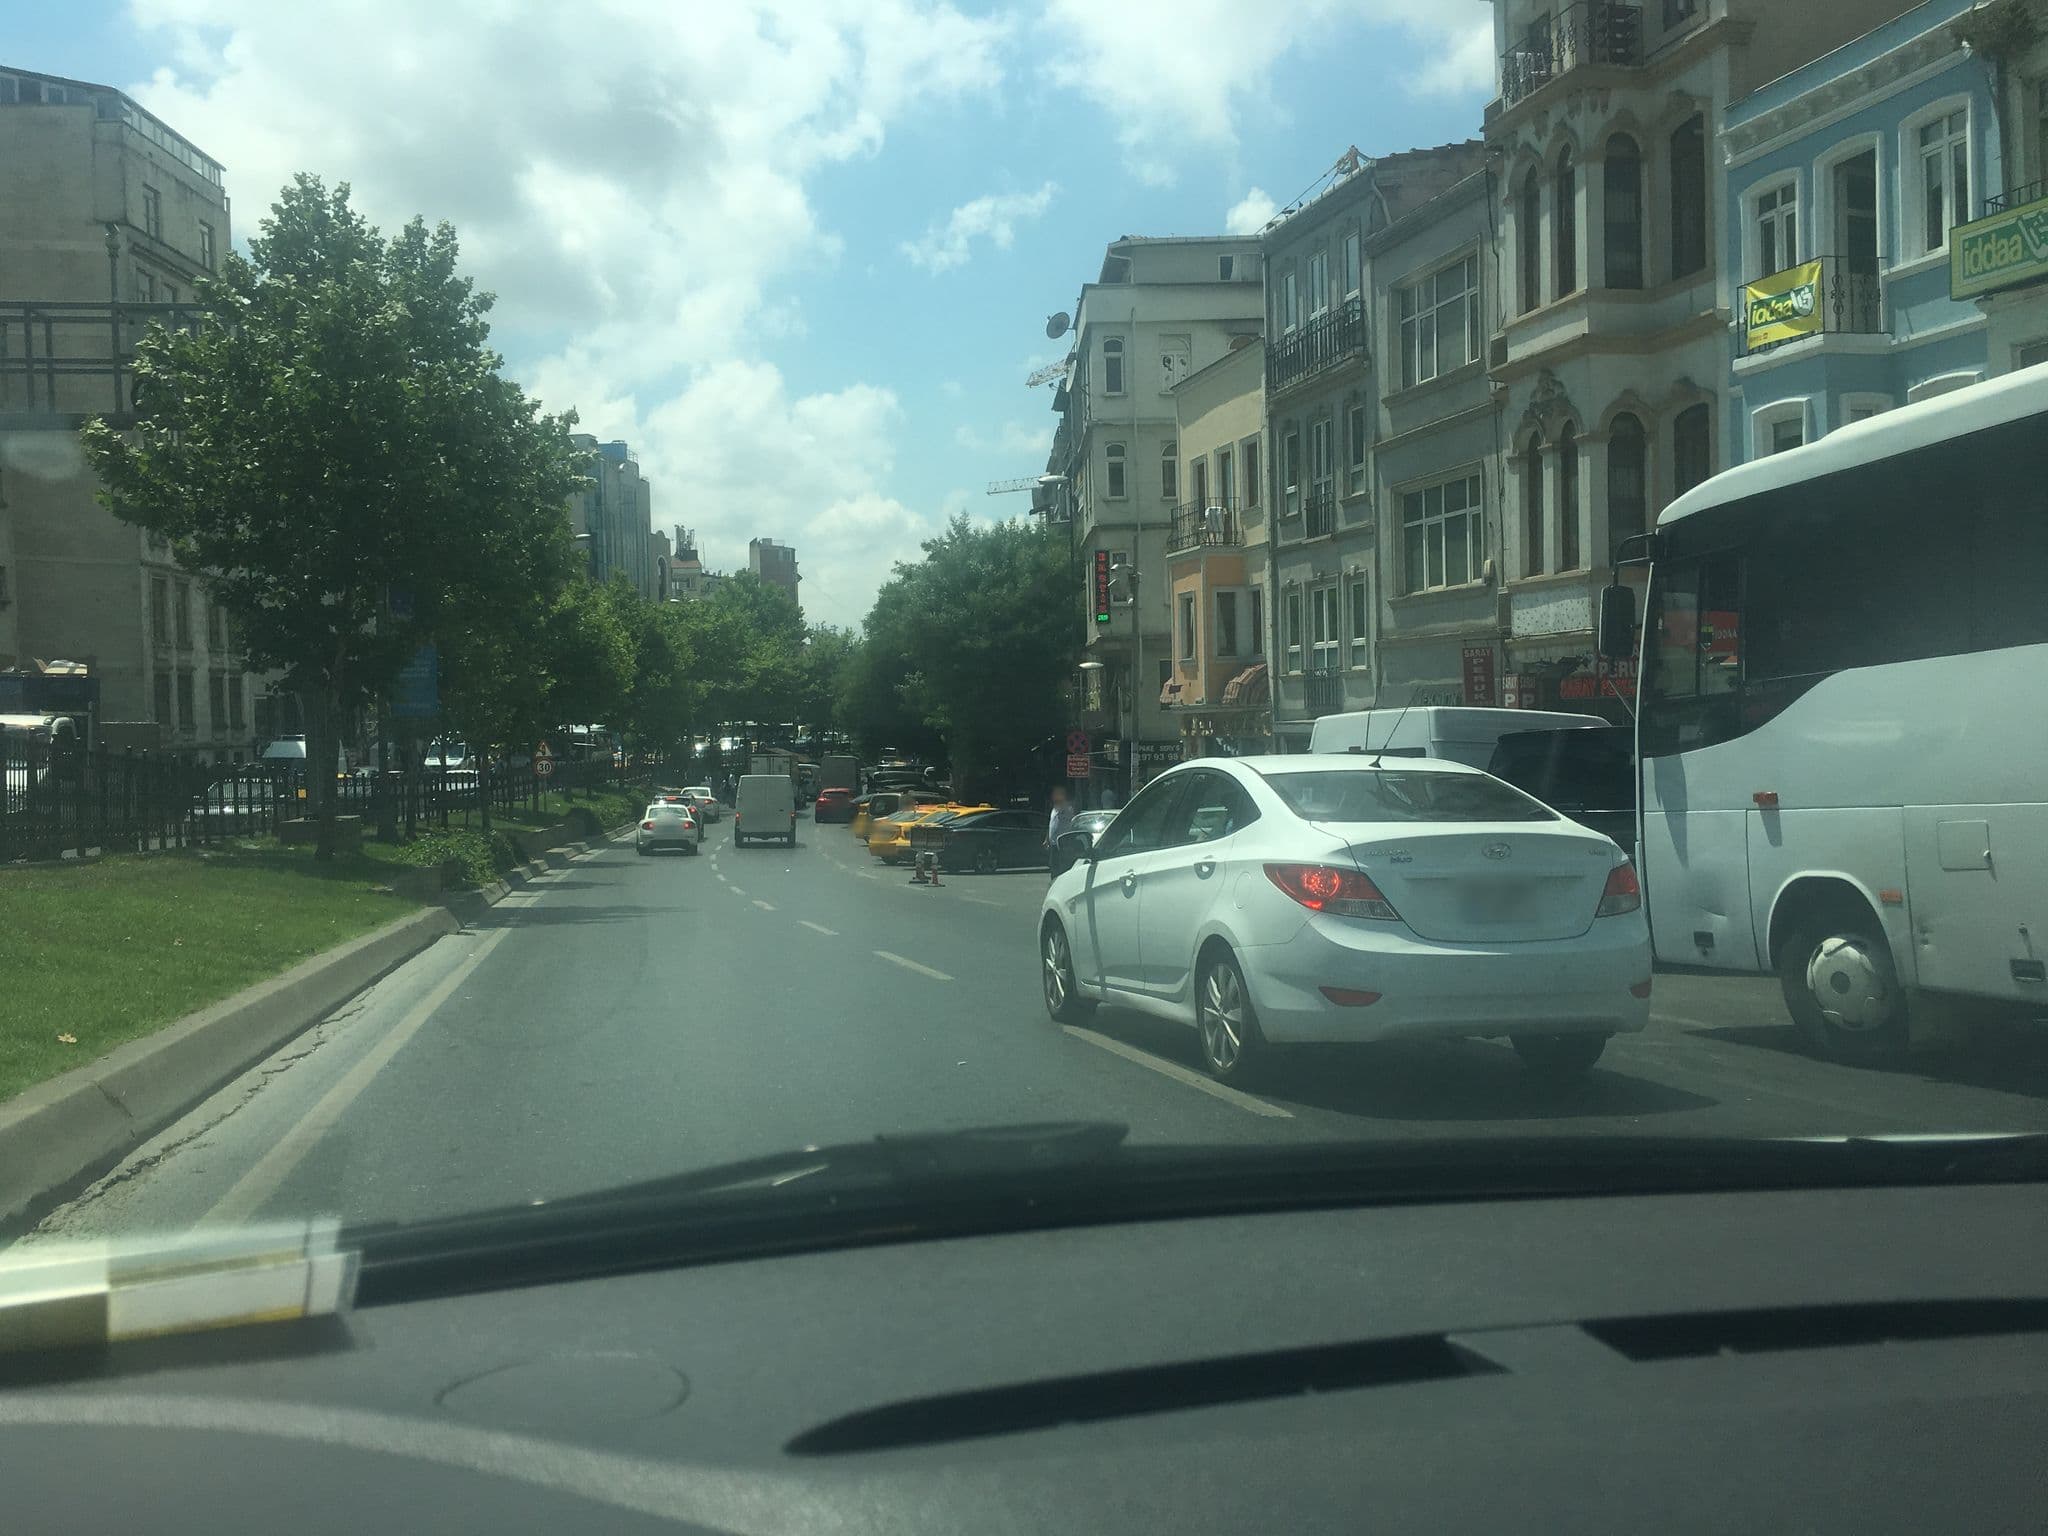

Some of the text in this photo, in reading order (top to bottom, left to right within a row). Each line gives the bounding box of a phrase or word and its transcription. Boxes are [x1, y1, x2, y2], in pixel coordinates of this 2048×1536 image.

[1963, 233, 2023, 275] iddaa
[1751, 299, 1793, 326] iddaa
[1464, 648, 1491, 658] SARAY
[538, 762, 551, 772] 30
